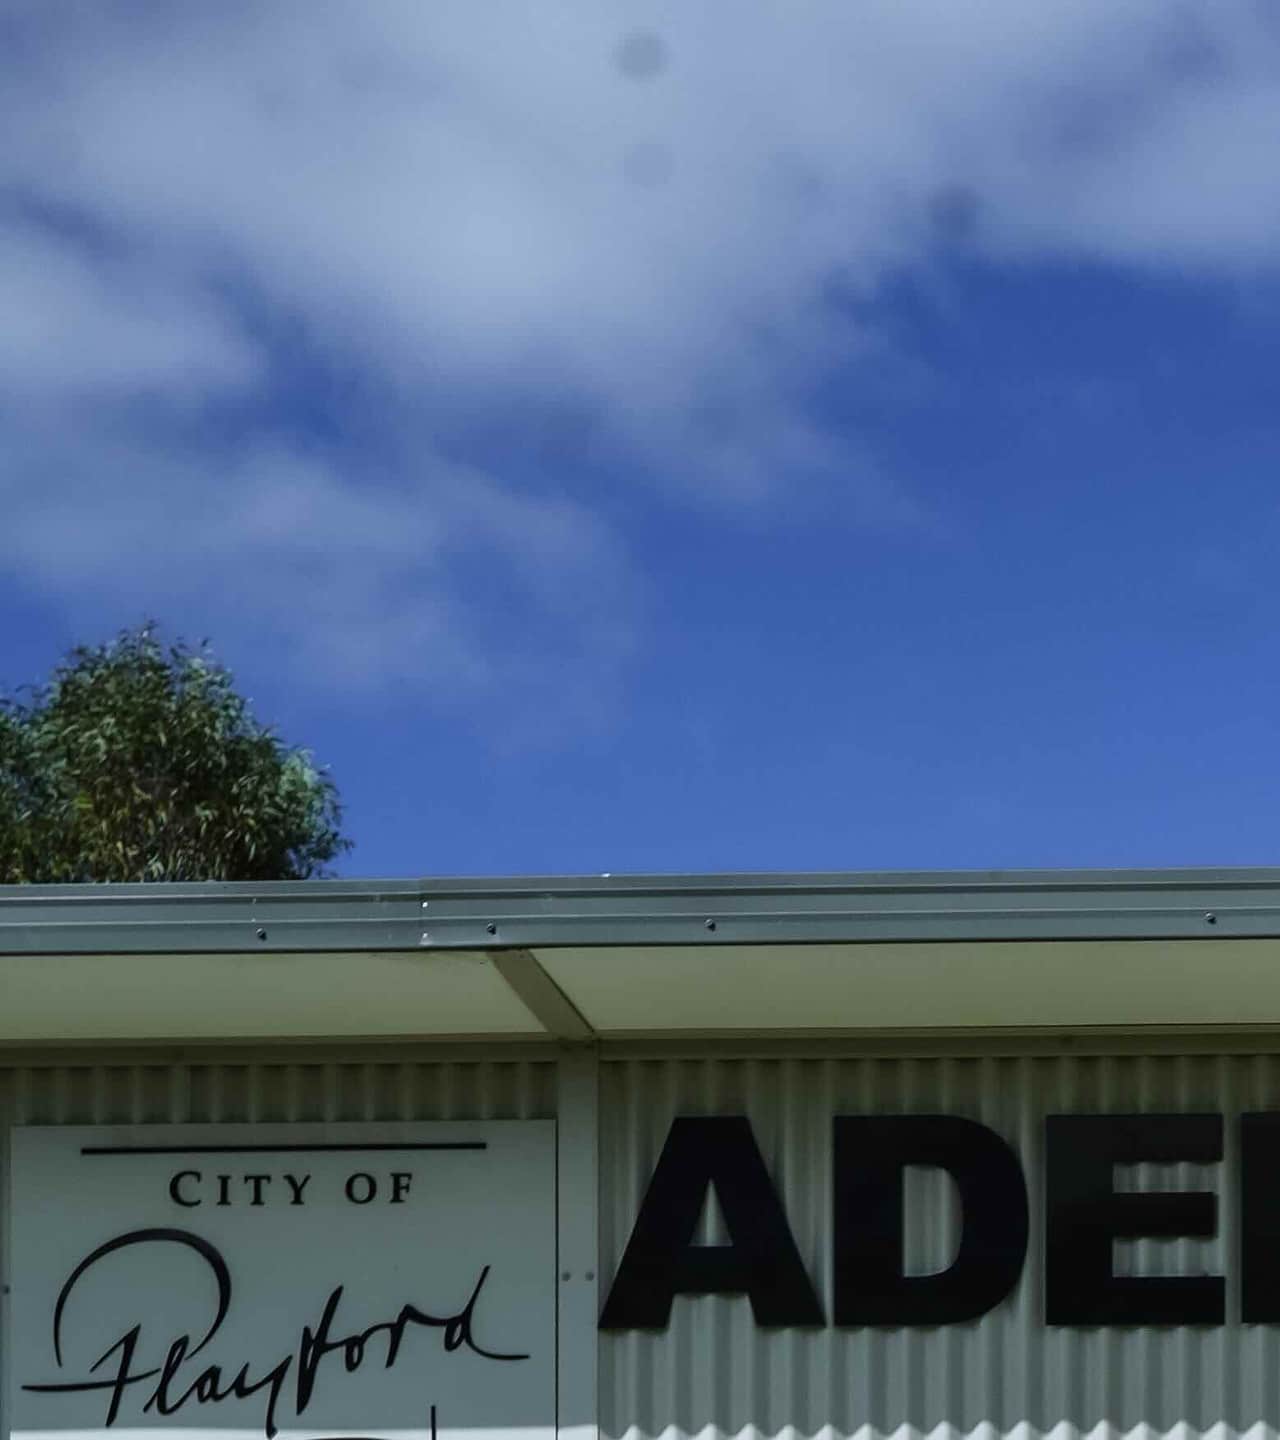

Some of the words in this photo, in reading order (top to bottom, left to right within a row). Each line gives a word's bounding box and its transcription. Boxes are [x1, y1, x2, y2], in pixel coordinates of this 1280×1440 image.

[168, 1168, 314, 1209] CITY
[344, 1171, 415, 1207] OF
[21, 1228, 531, 1439] Playford
